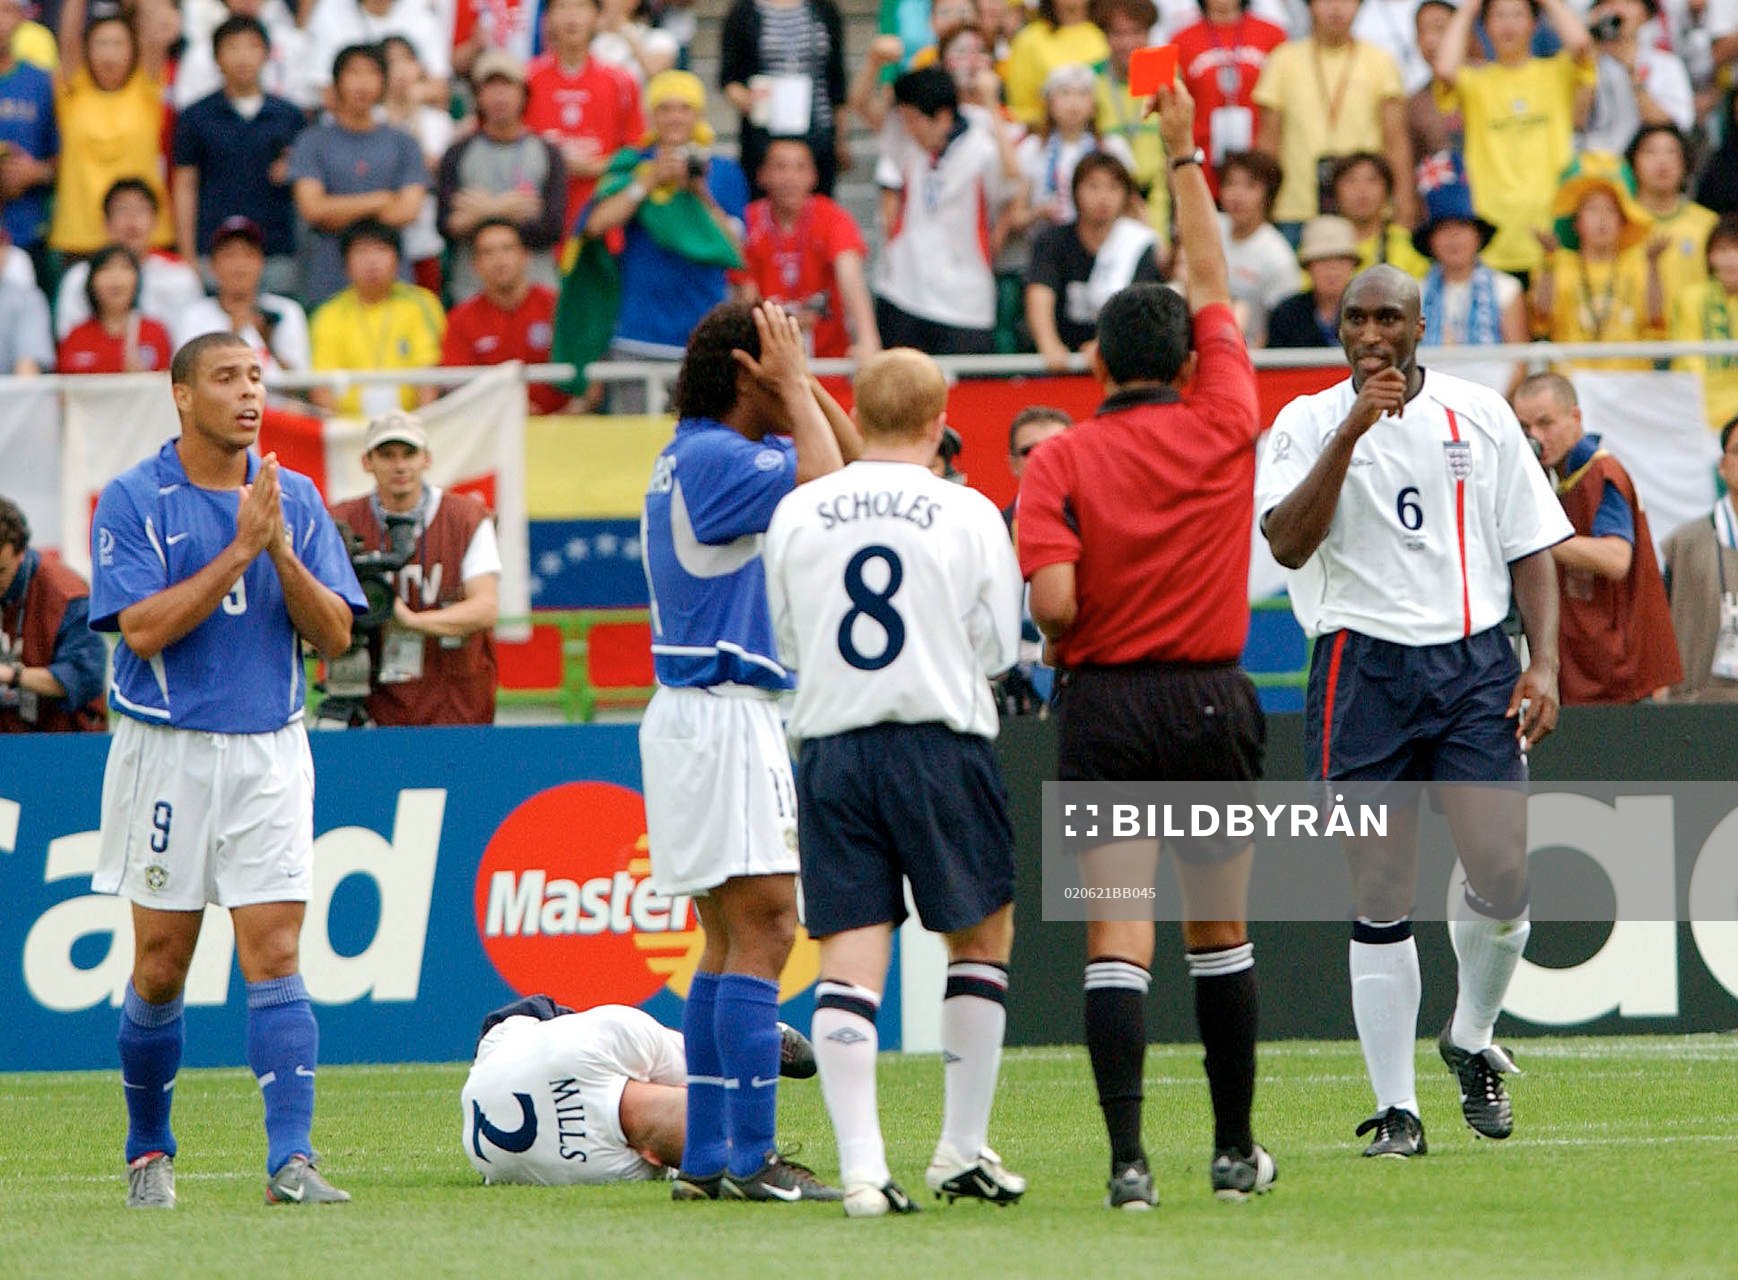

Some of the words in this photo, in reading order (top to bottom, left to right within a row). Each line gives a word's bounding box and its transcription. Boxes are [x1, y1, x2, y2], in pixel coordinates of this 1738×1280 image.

[817, 490, 942, 530] SCHOLES
[1396, 486, 1424, 531] 6
[837, 545, 905, 671] 8
[150, 801, 172, 853] 9
[0, 788, 447, 1012] ad
[472, 1092, 538, 1164] 2
[549, 1077, 588, 1164] MILLS
